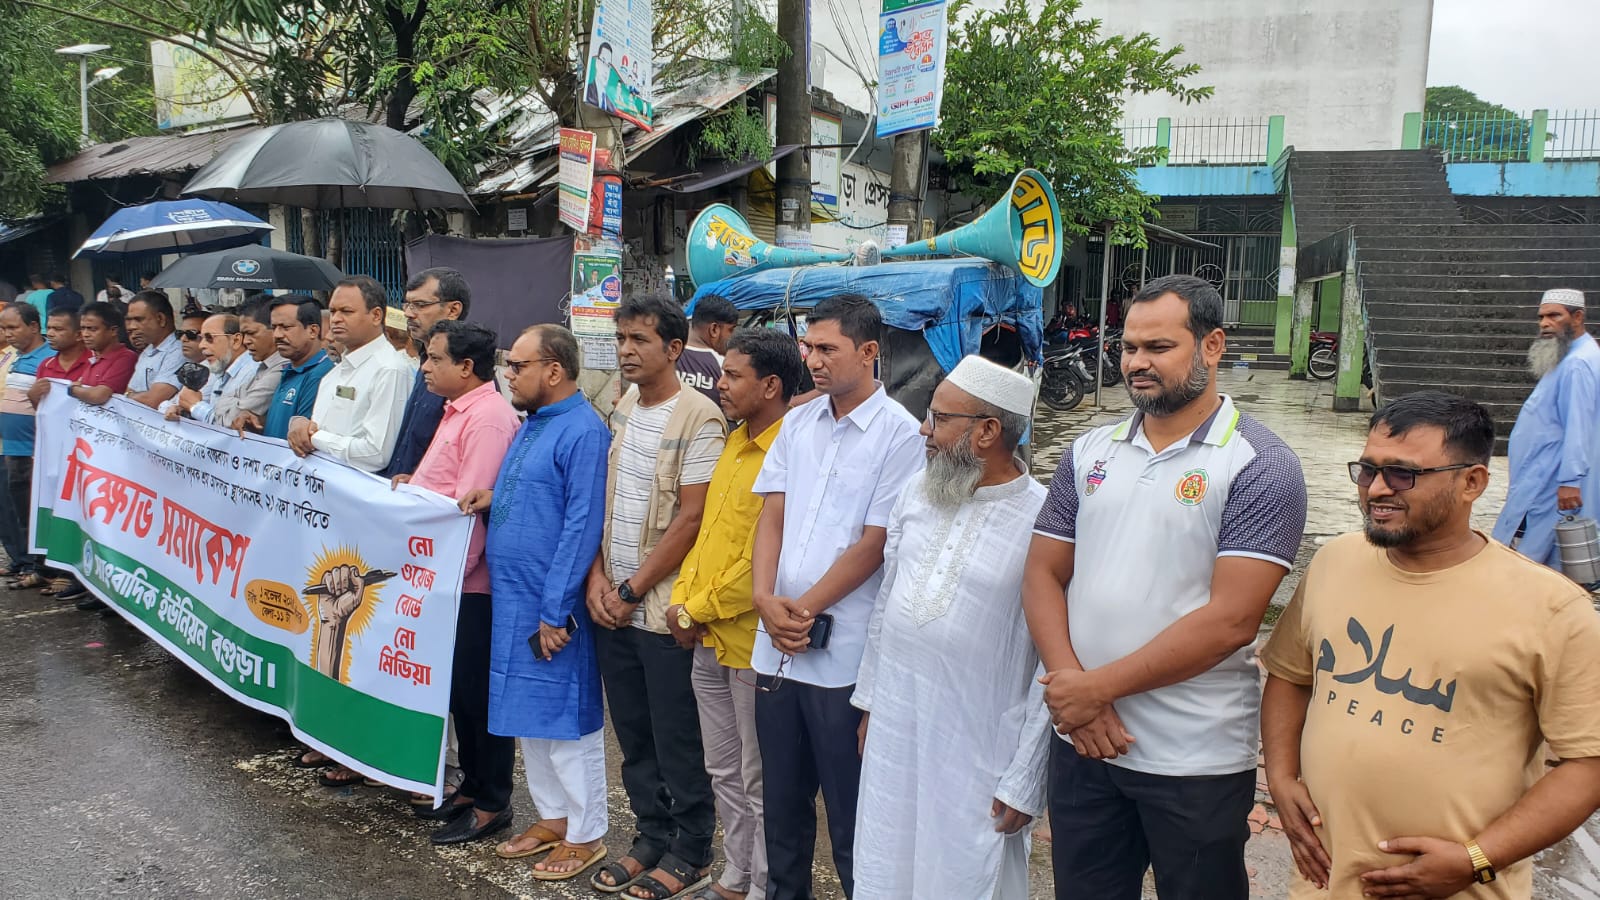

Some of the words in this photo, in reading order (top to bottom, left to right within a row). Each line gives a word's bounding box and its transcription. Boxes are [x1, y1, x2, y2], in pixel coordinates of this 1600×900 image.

[232, 455, 240, 470] ও
[305, 468, 325, 499] গঠন
[276, 497, 290, 519] ফা
[293, 501, 330, 529] দাবিতে
[158, 496, 251, 600] সমাবেশ
[408, 535, 434, 558] নো
[402, 564, 437, 591] ওয়েজ
[94, 553, 160, 611] সাংবাদিক
[158, 587, 208, 652] ইউনিয়ন
[395, 595, 425, 619] বোর্ড
[394, 627, 417, 651] নো
[379, 645, 432, 686] মিডিয়া
[1313, 617, 1457, 713] سلام
[1327, 690, 1445, 744] PEACE
